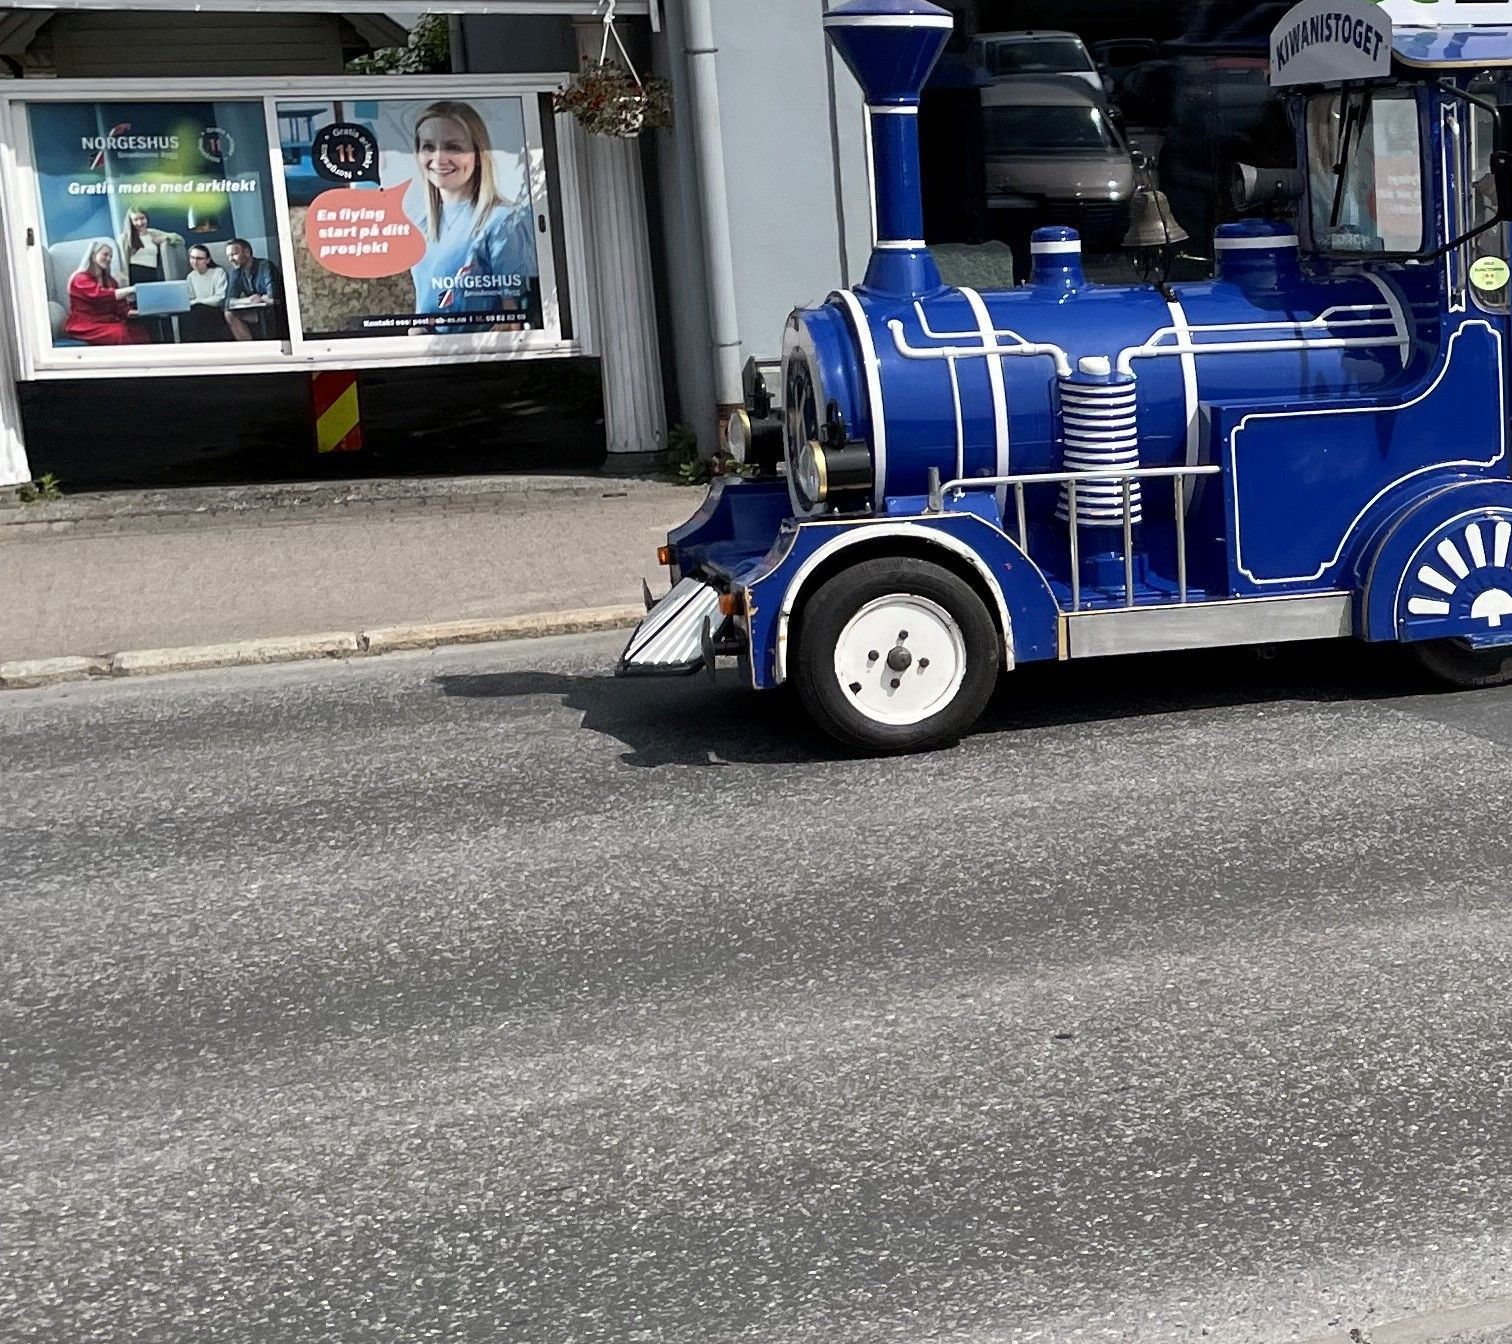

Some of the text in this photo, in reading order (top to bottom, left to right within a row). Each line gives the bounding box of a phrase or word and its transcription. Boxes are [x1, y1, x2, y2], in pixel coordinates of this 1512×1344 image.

[1276, 12, 1383, 71] KIWANISTOGET
[81, 135, 179, 150] NORGESHUS
[68, 181, 114, 195] Gratis
[159, 180, 194, 193] med
[196, 179, 257, 193] arkitekt
[316, 207, 386, 223] En flying
[318, 223, 411, 240] start på ditt
[320, 241, 389, 258] prosjekt
[431, 273, 522, 290] NORGESHUS
